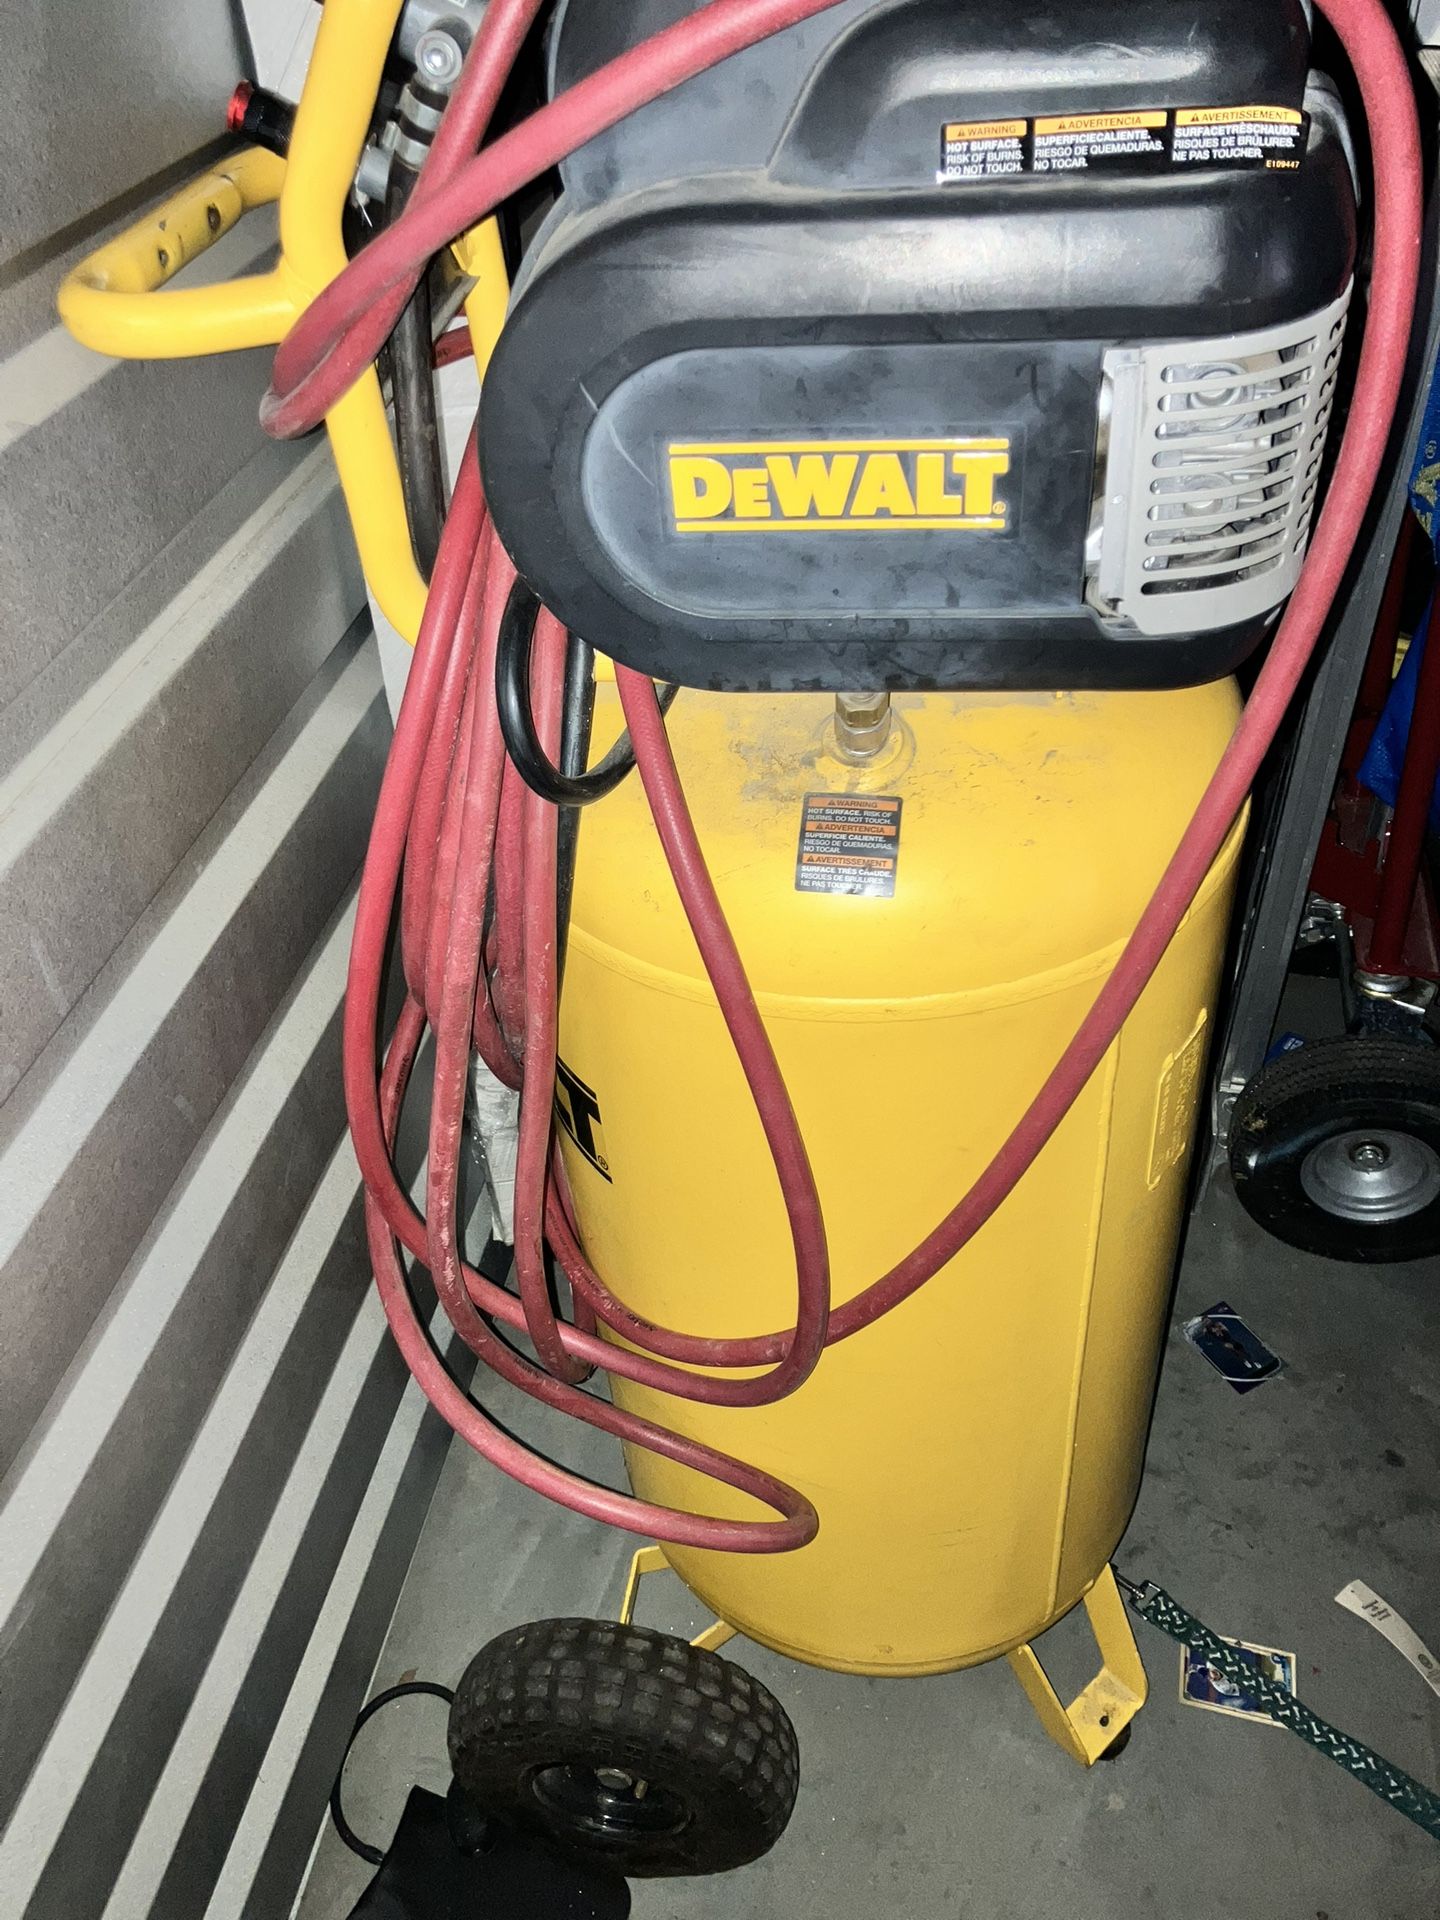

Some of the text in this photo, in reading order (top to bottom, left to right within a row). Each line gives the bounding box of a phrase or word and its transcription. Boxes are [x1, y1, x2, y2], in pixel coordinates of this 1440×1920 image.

[1202, 110, 1289, 121] AVERTISSEMENT
[1068, 116, 1142, 129] ADVERTENCIA
[968, 125, 1016, 136] WARNING
[947, 138, 1022, 153] HOT SURFACE.
[1174, 137, 1219, 149] RISQUES
[1221, 136, 1236, 147] DE
[1035, 140, 1164, 158] RIESGO DE QUEMADURAS.
[1172, 147, 1264, 161] NE PAS TOUCHER.
[947, 150, 1024, 164] RISK OF BURNS.
[947, 161, 1023, 176] DO NOT TOUCH.
[1034, 157, 1088, 170] NO TOCAR.
[836, 799, 878, 809] WARNING
[825, 808, 861, 816] SURFACE.
[863, 810, 881, 818] RISK
[864, 817, 892, 825] TOUCH.
[824, 823, 885, 834] ADVERTENCIA
[805, 832, 886, 843] SUPERFICIE CALIENTE.
[804, 838, 830, 846] RIESGO
[842, 841, 893, 850] QUEMADURAS.
[815, 846, 840, 854] TOCAR.
[814, 856, 888, 868] AVERTISSEMENT
[801, 865, 836, 874] SURFACE
[801, 873, 832, 881] RISQUES
[833, 874, 845, 882] DE
[812, 880, 826, 888] PAS
